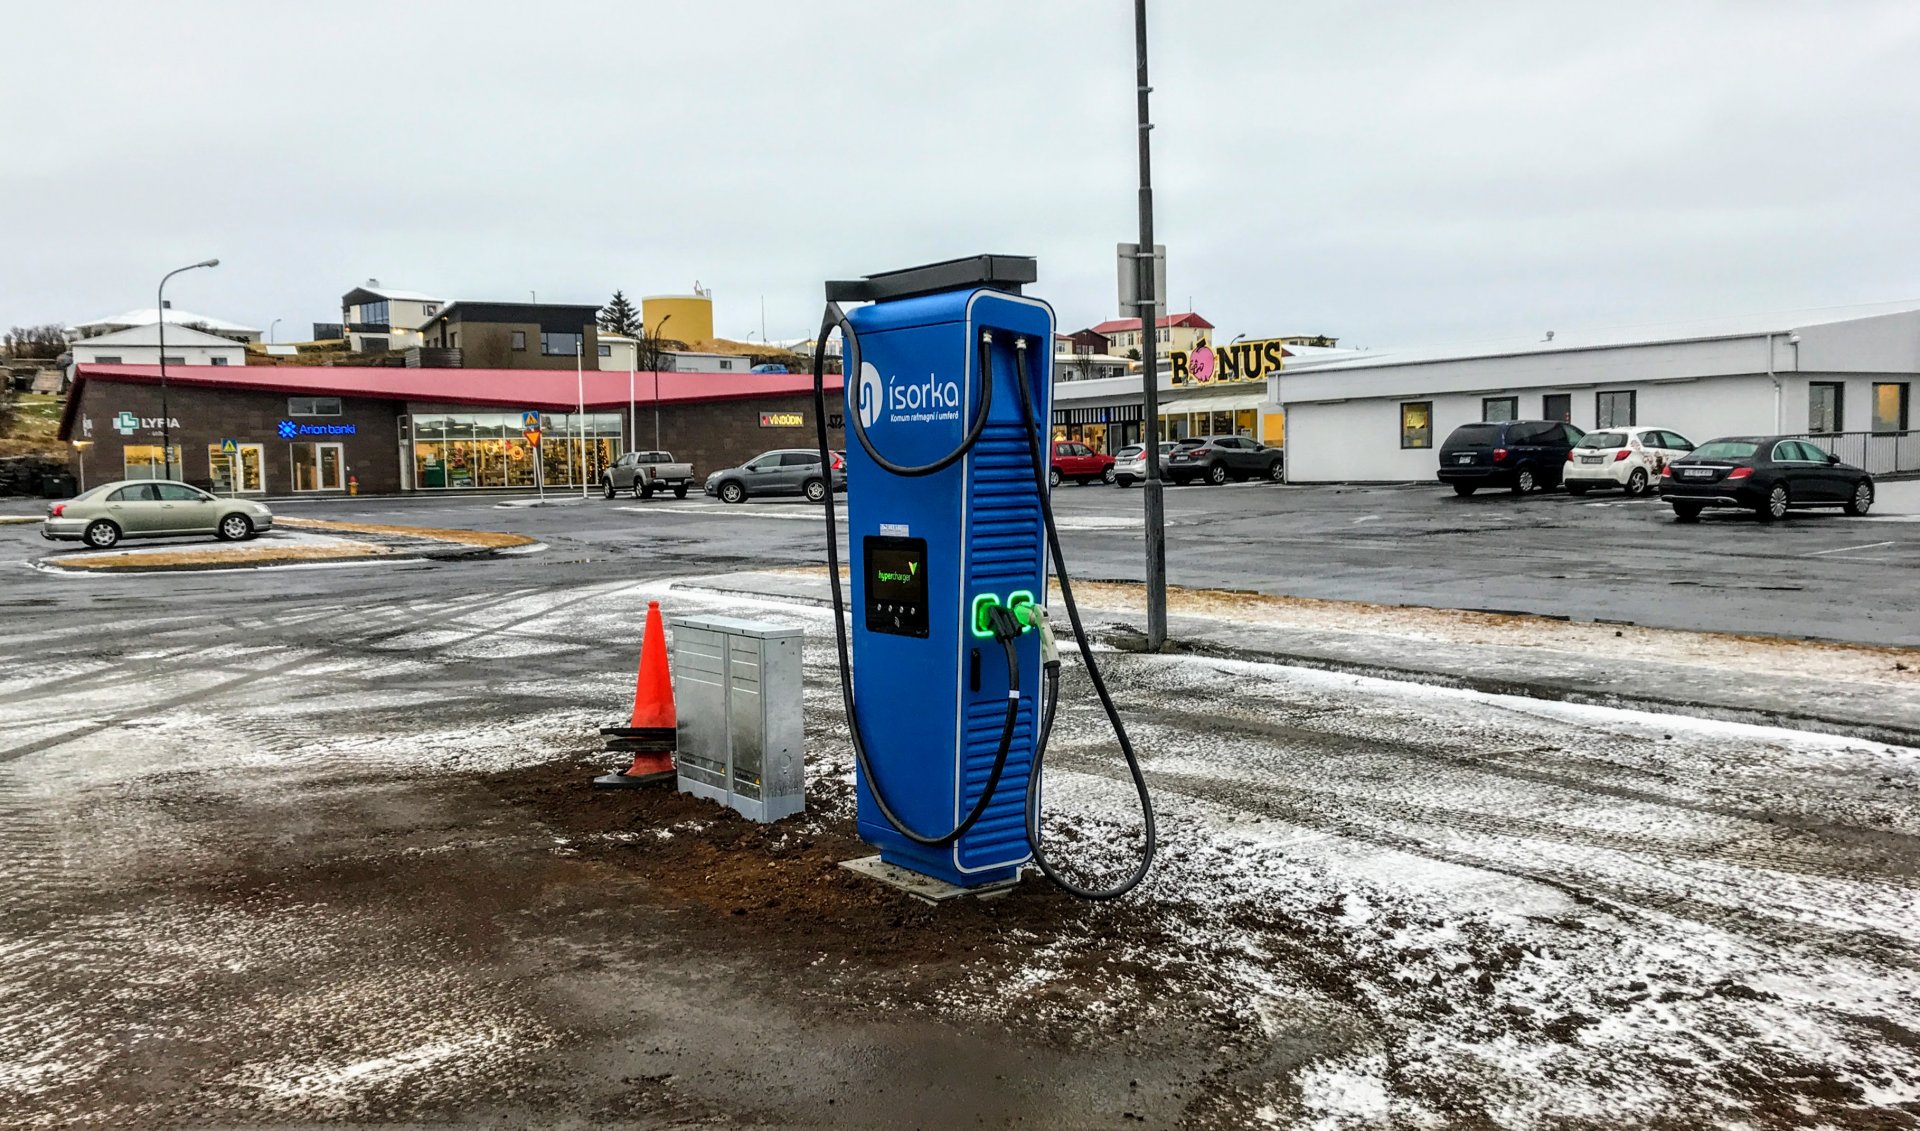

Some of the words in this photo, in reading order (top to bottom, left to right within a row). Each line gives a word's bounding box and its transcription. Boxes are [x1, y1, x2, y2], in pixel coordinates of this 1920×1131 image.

[889, 372, 959, 410] ísorka
[890, 413, 910, 422] Komum
[911, 411, 935, 423] rafmagni
[299, 424, 327, 435] Arion
[327, 424, 356, 435] banki
[878, 569, 911, 584] hypercharger
